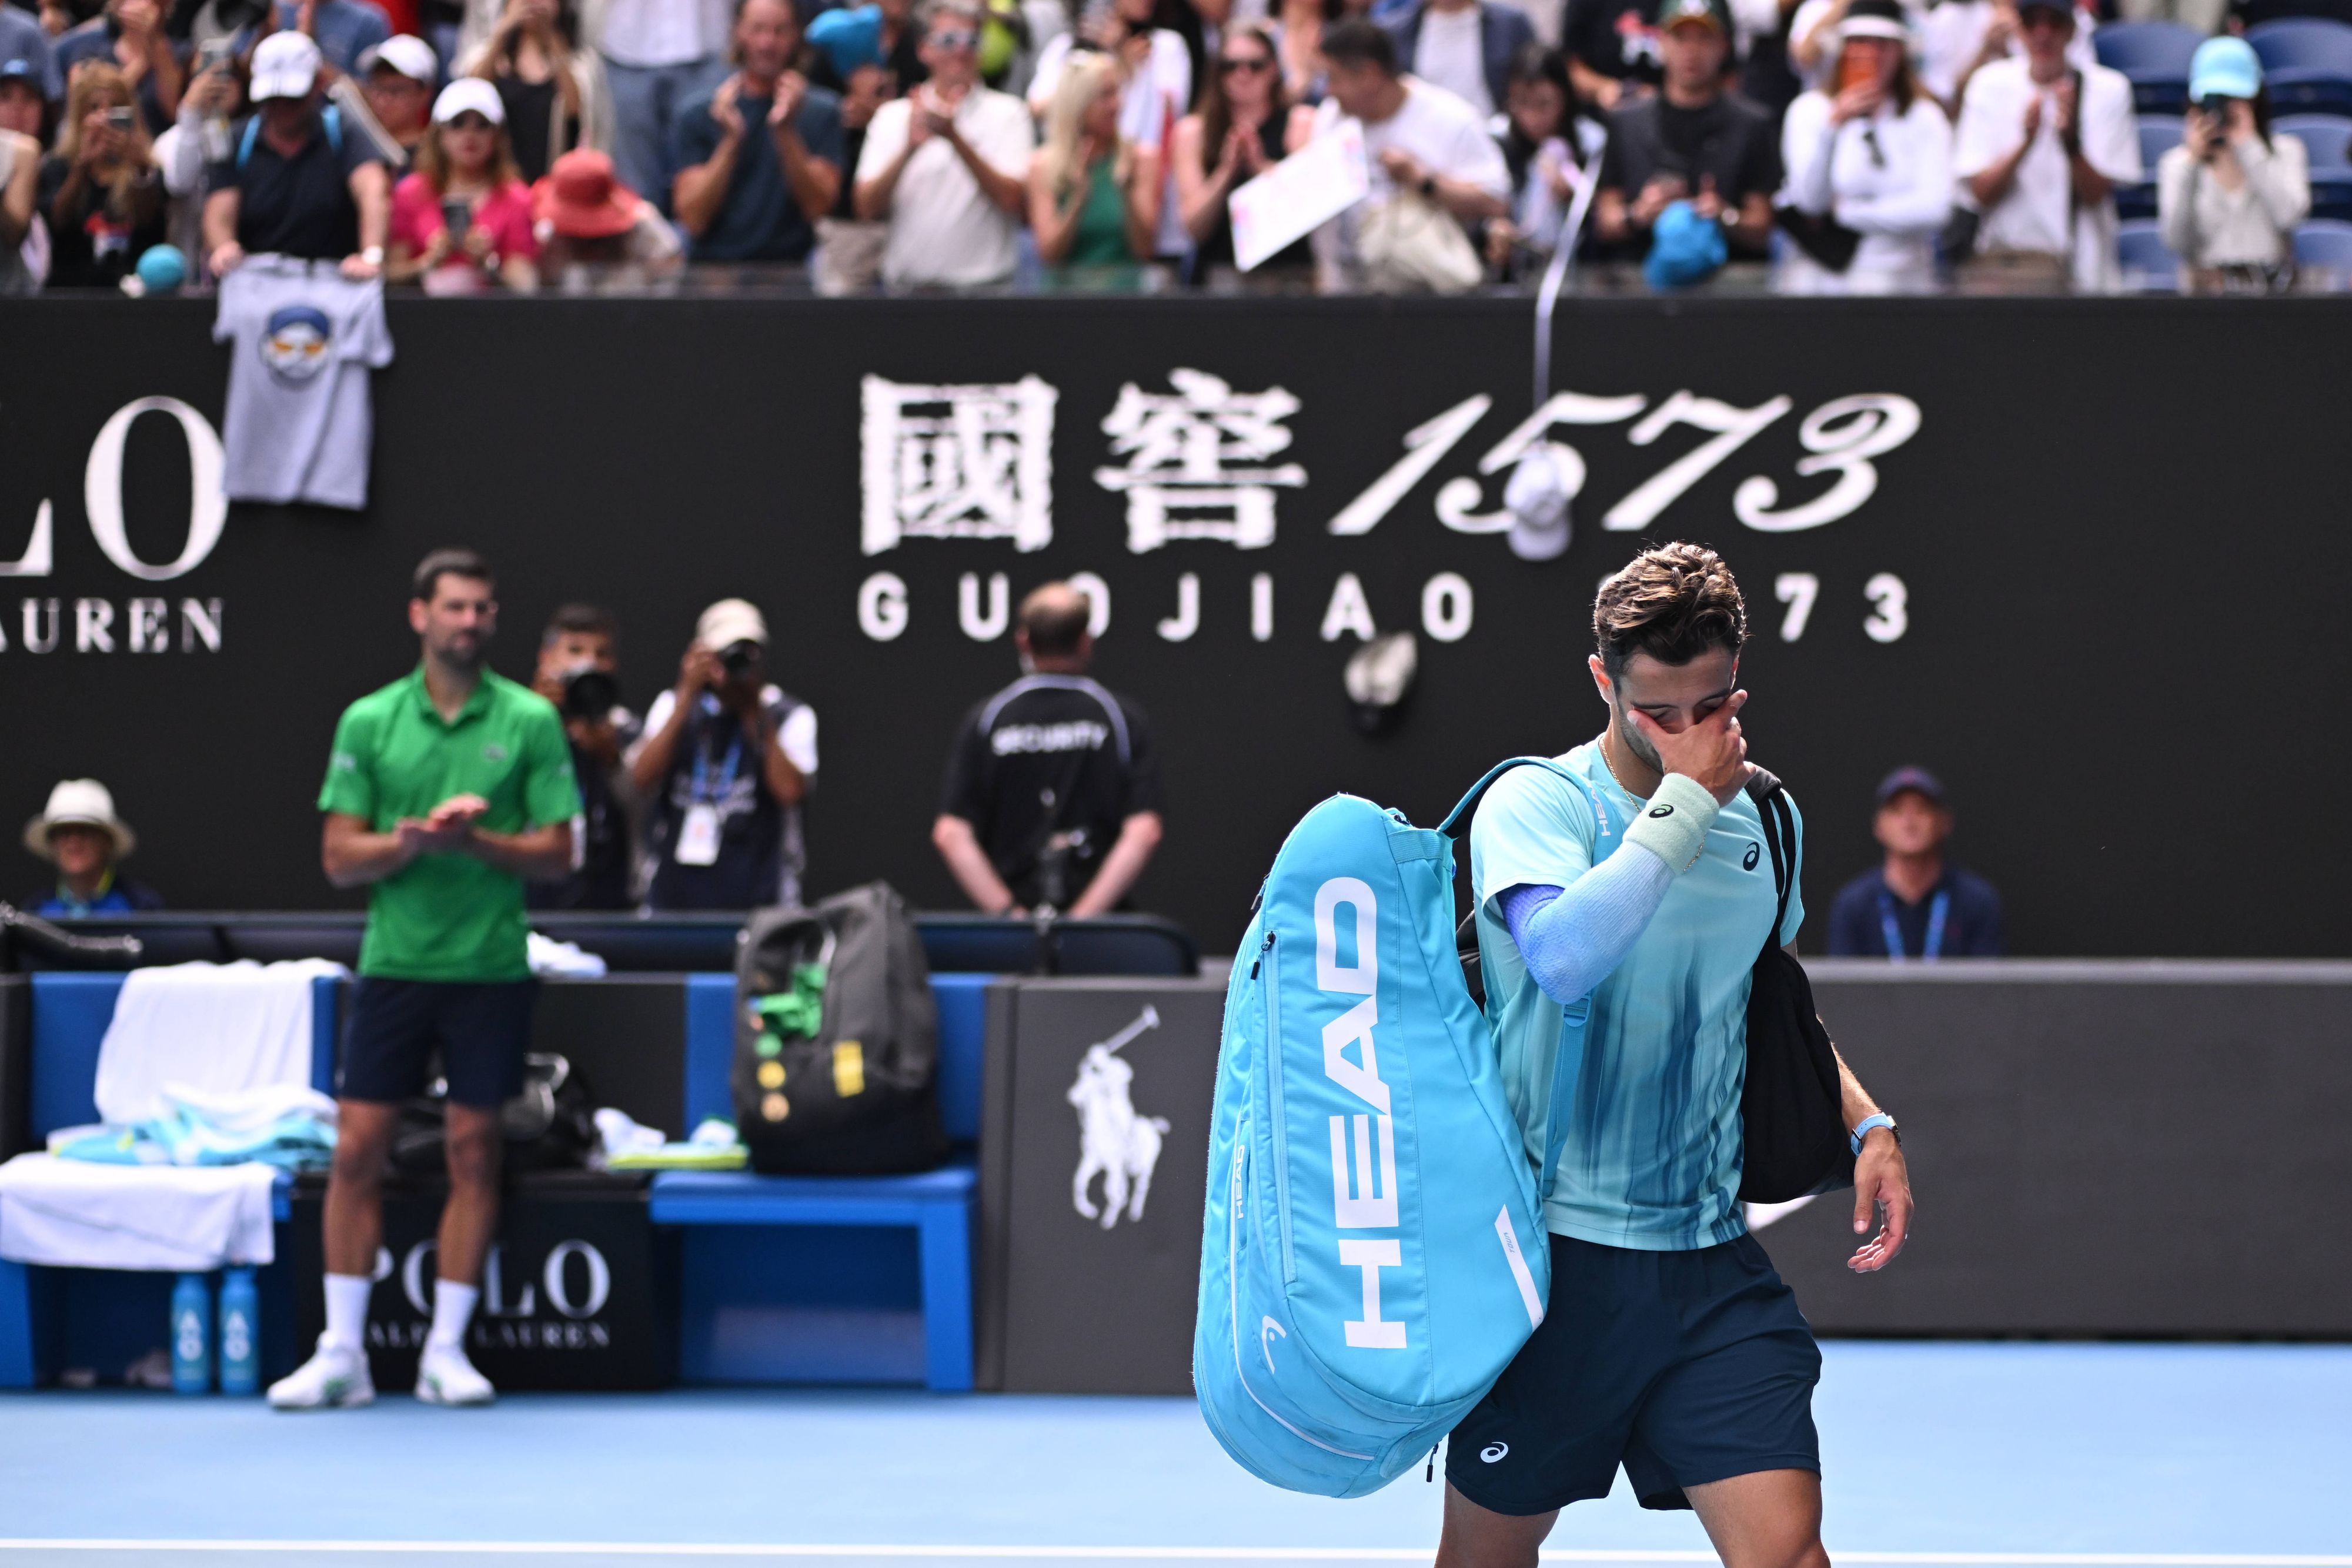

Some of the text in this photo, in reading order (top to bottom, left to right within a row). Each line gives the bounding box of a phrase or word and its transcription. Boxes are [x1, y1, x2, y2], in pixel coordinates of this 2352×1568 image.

[859, 369, 1922, 556] 國窖 1573
[0, 597, 223, 654] UREN
[991, 721, 1109, 756] SECURITY
[1314, 876, 1407, 1350] HEAD
[1235, 1144, 1245, 1219] HEAD
[374, 1238, 610, 1319] OLO
[363, 1320, 610, 1349] ALP LAUREN
